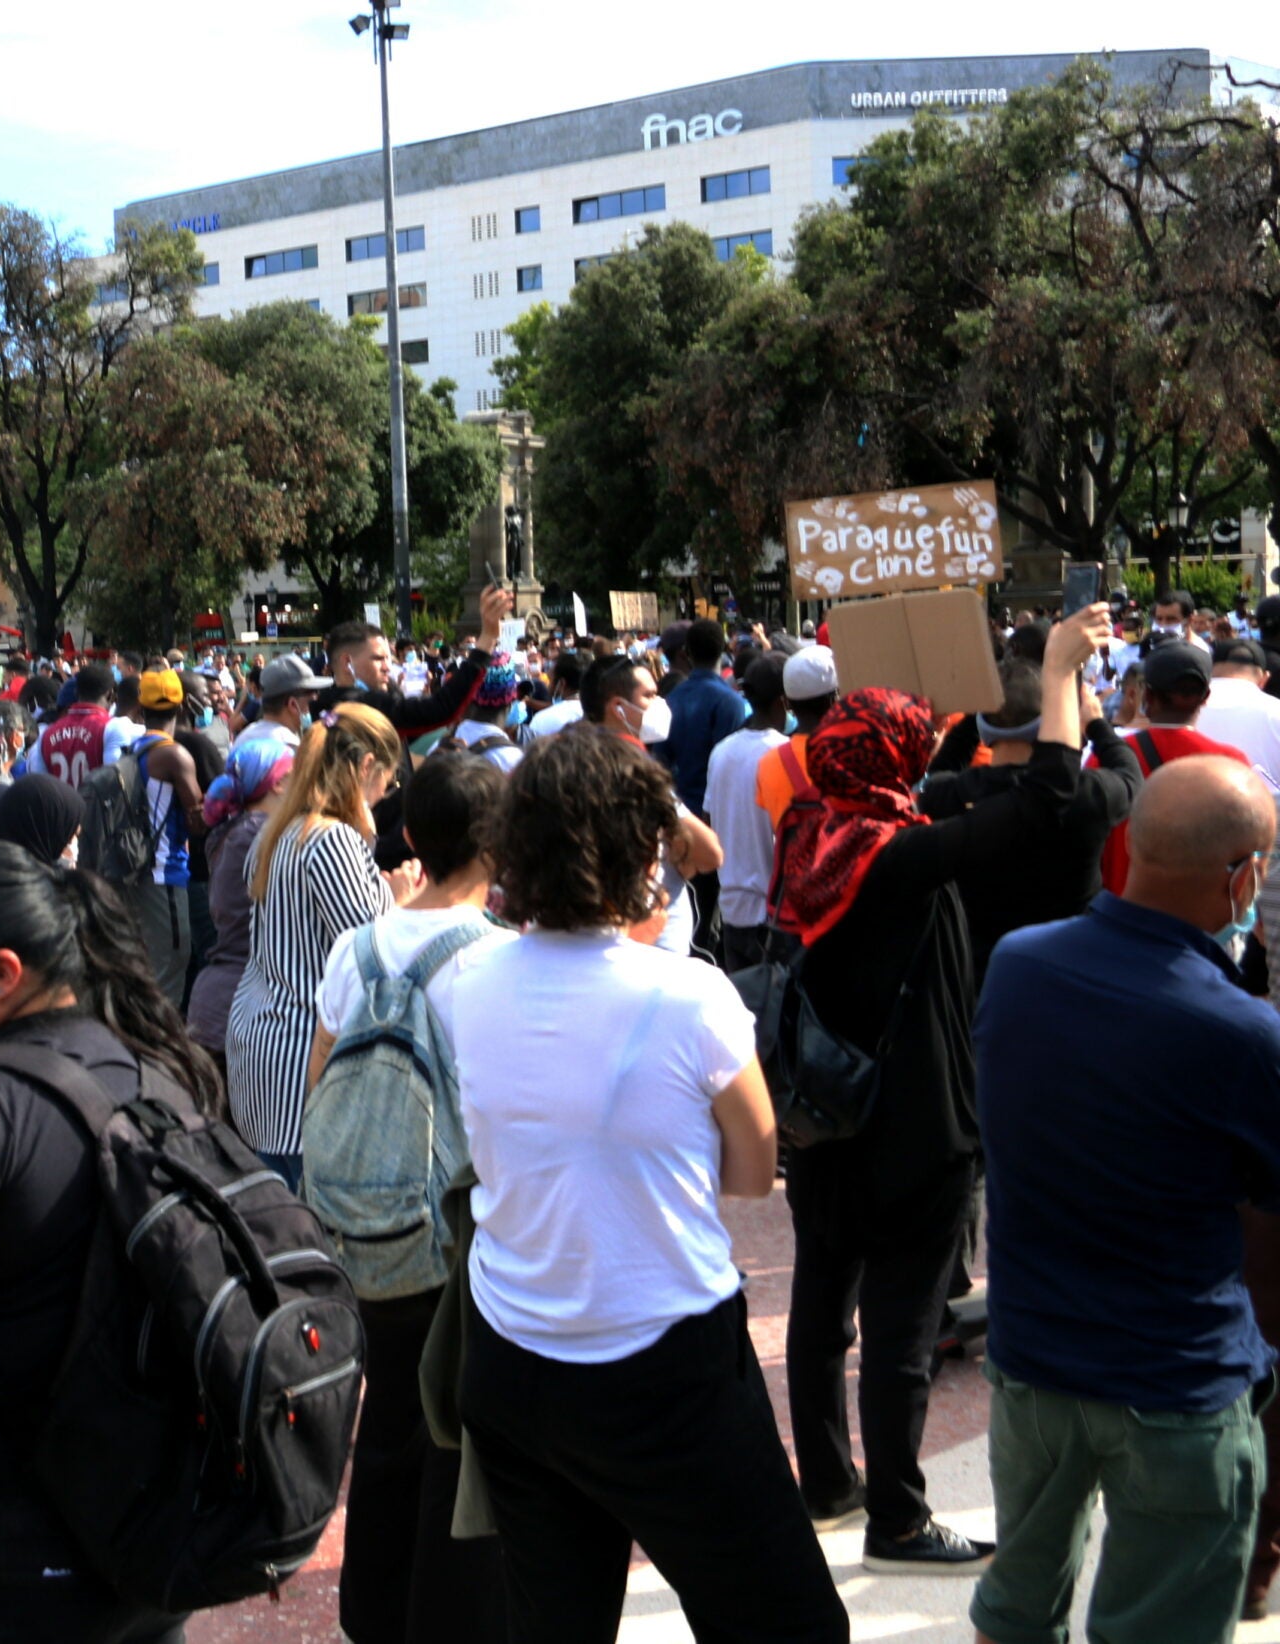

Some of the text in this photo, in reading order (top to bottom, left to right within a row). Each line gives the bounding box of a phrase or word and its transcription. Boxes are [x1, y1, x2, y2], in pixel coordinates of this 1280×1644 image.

[851, 87, 1007, 109] URBAN OUTFITTERS
[640, 107, 743, 151] fnac
